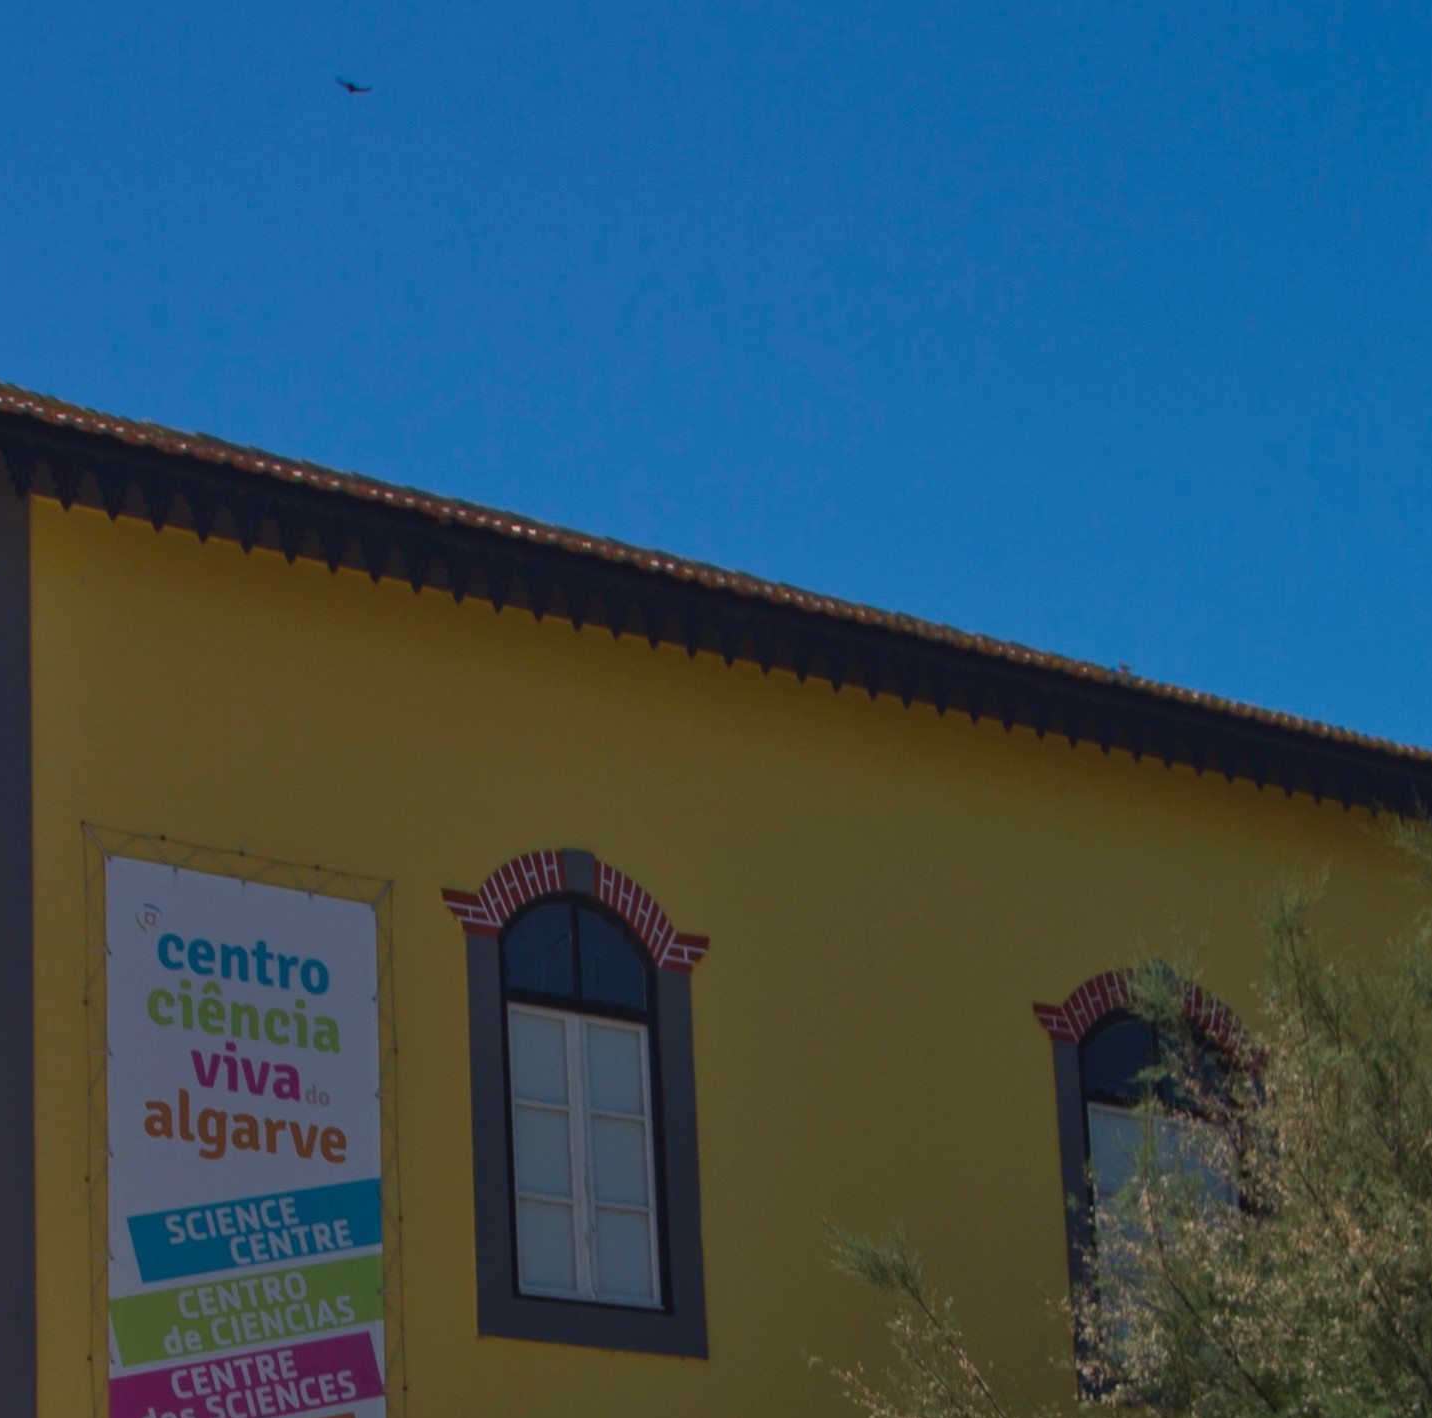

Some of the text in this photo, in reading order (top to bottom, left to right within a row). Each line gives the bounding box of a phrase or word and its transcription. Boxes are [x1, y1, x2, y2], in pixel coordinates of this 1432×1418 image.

[157, 933, 330, 995] centro
[147, 979, 341, 1053] ciência
[190, 1041, 331, 1107] viva do
[143, 1088, 347, 1164] algarve
[165, 1197, 300, 1245] SCIENCE
[229, 1219, 354, 1265] CENTRE
[163, 1295, 355, 1356] de CIENCIAS
[177, 1271, 308, 1321] CENTRO
[170, 1350, 298, 1400] CENTRE
